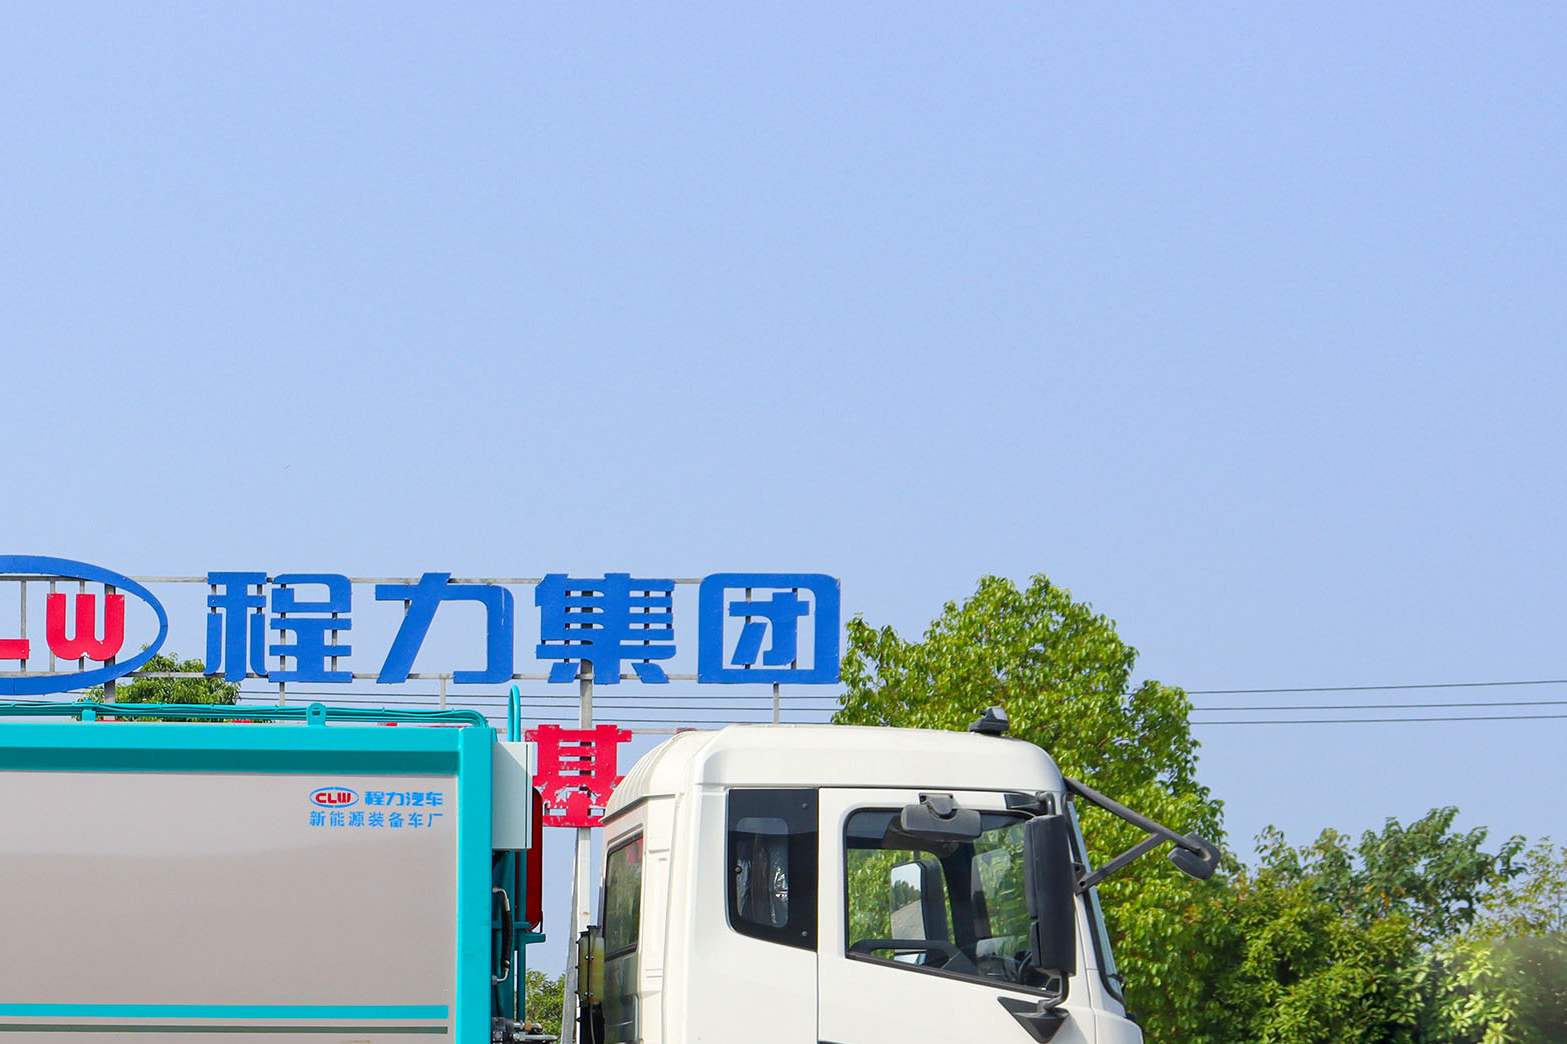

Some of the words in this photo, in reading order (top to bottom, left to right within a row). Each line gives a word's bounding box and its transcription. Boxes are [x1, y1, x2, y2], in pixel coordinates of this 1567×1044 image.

[204, 571, 841, 685] 程力集团
[315, 791, 352, 805] CLW
[364, 790, 443, 807] 程力汽车
[309, 810, 443, 828] 新能源装备车厂
